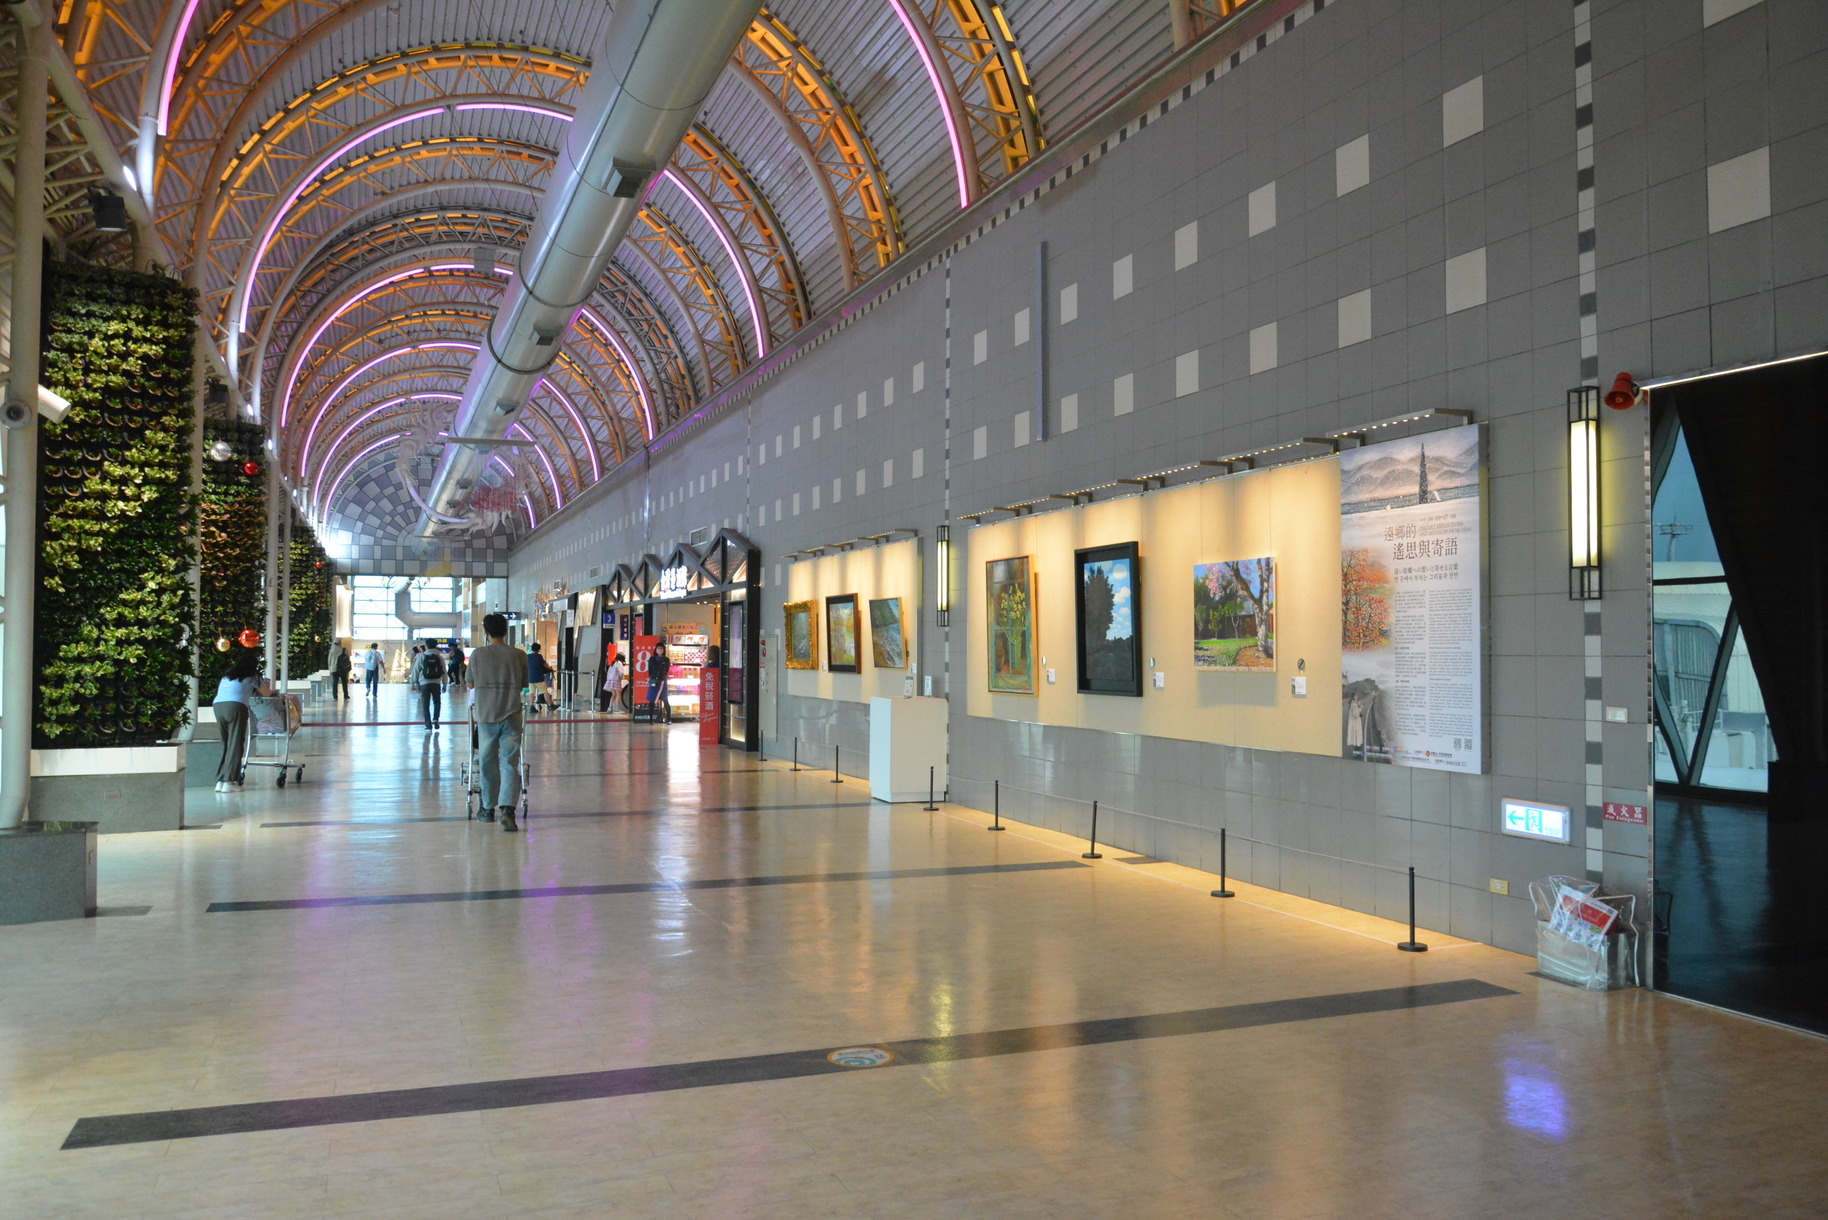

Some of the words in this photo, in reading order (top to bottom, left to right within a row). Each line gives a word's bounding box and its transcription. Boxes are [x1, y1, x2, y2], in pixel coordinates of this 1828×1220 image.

[1393, 537, 1458, 560] 遙思與寄語
[705, 672, 714, 711] 免稅菸酒
[1607, 803, 1642, 818] 滅火器
